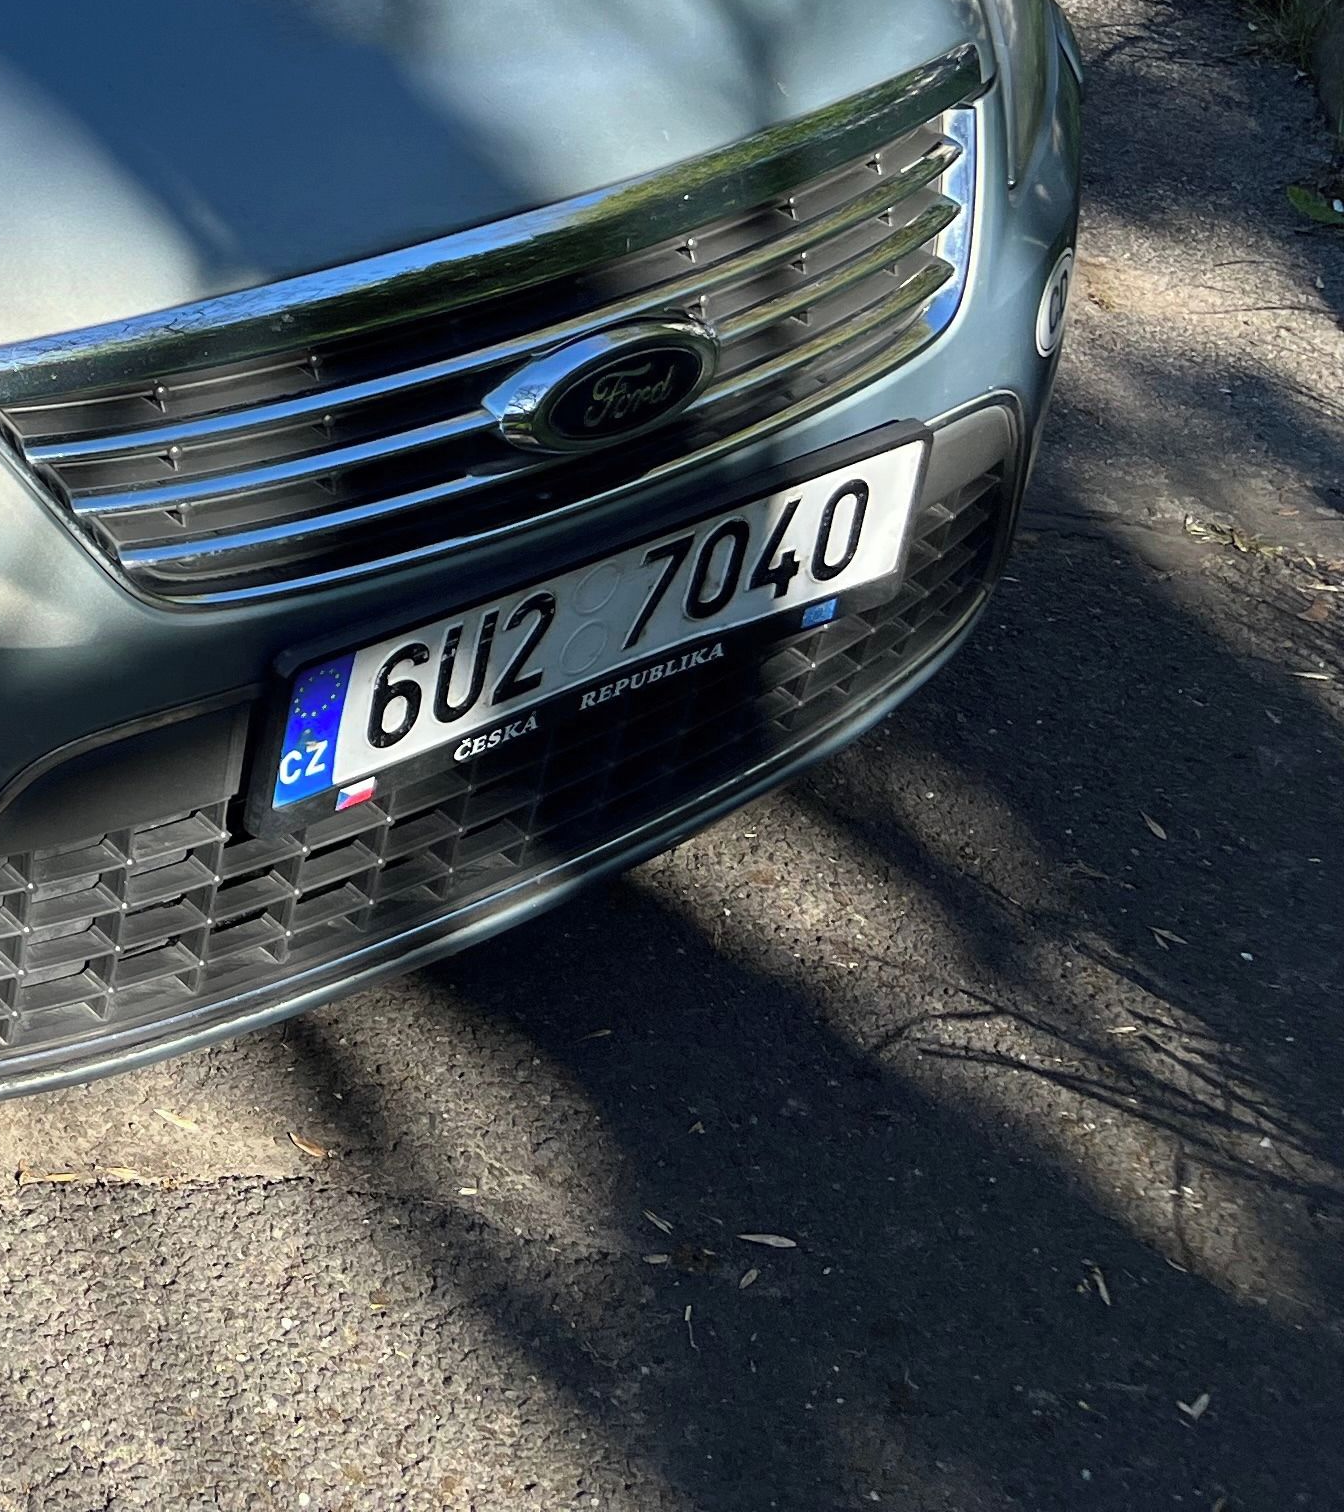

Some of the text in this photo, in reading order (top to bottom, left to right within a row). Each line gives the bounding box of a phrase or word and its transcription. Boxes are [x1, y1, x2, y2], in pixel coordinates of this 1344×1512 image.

[583, 362, 675, 428] Ford
[367, 479, 870, 750] 6U2 7040
[453, 642, 725, 763] ČESKÁ REPUBLIKA
[278, 740, 327, 786] CZ
